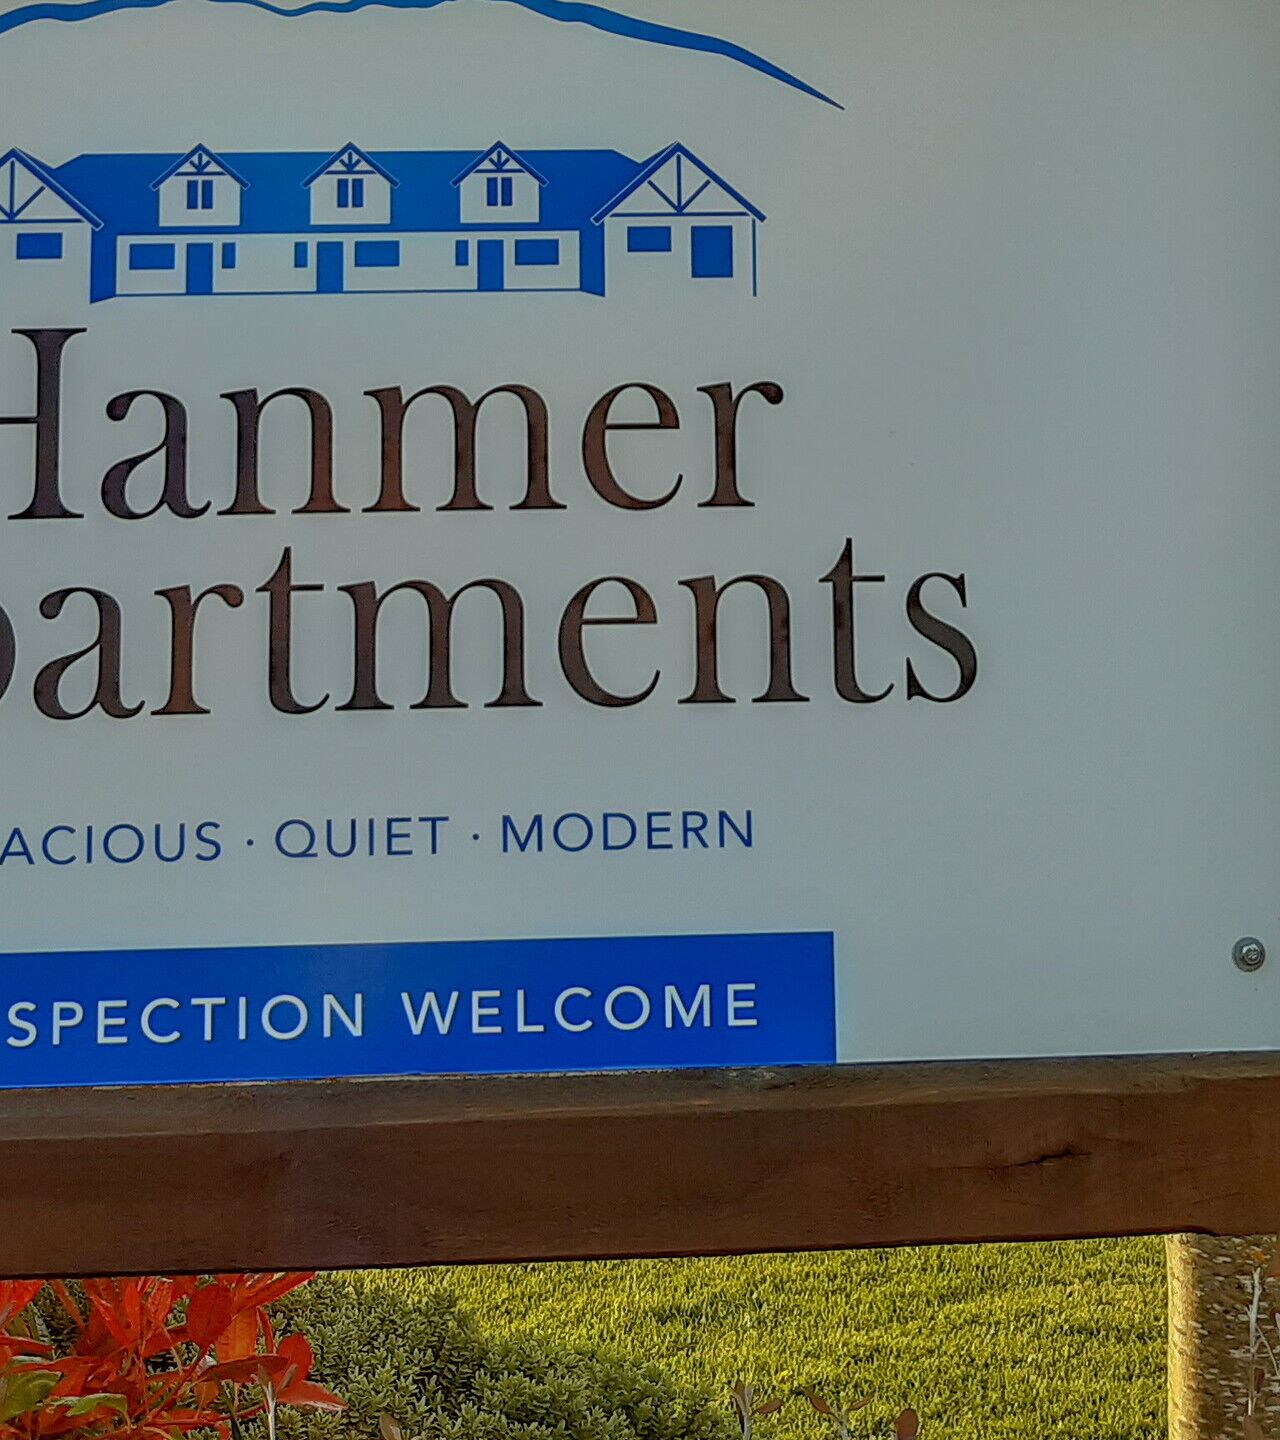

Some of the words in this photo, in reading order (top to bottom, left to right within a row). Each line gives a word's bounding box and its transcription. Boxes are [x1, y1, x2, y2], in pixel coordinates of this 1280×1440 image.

[273, 815, 452, 860] QUIET
[499, 808, 755, 854] MODERN
[400, 981, 760, 1038] WELCOME
